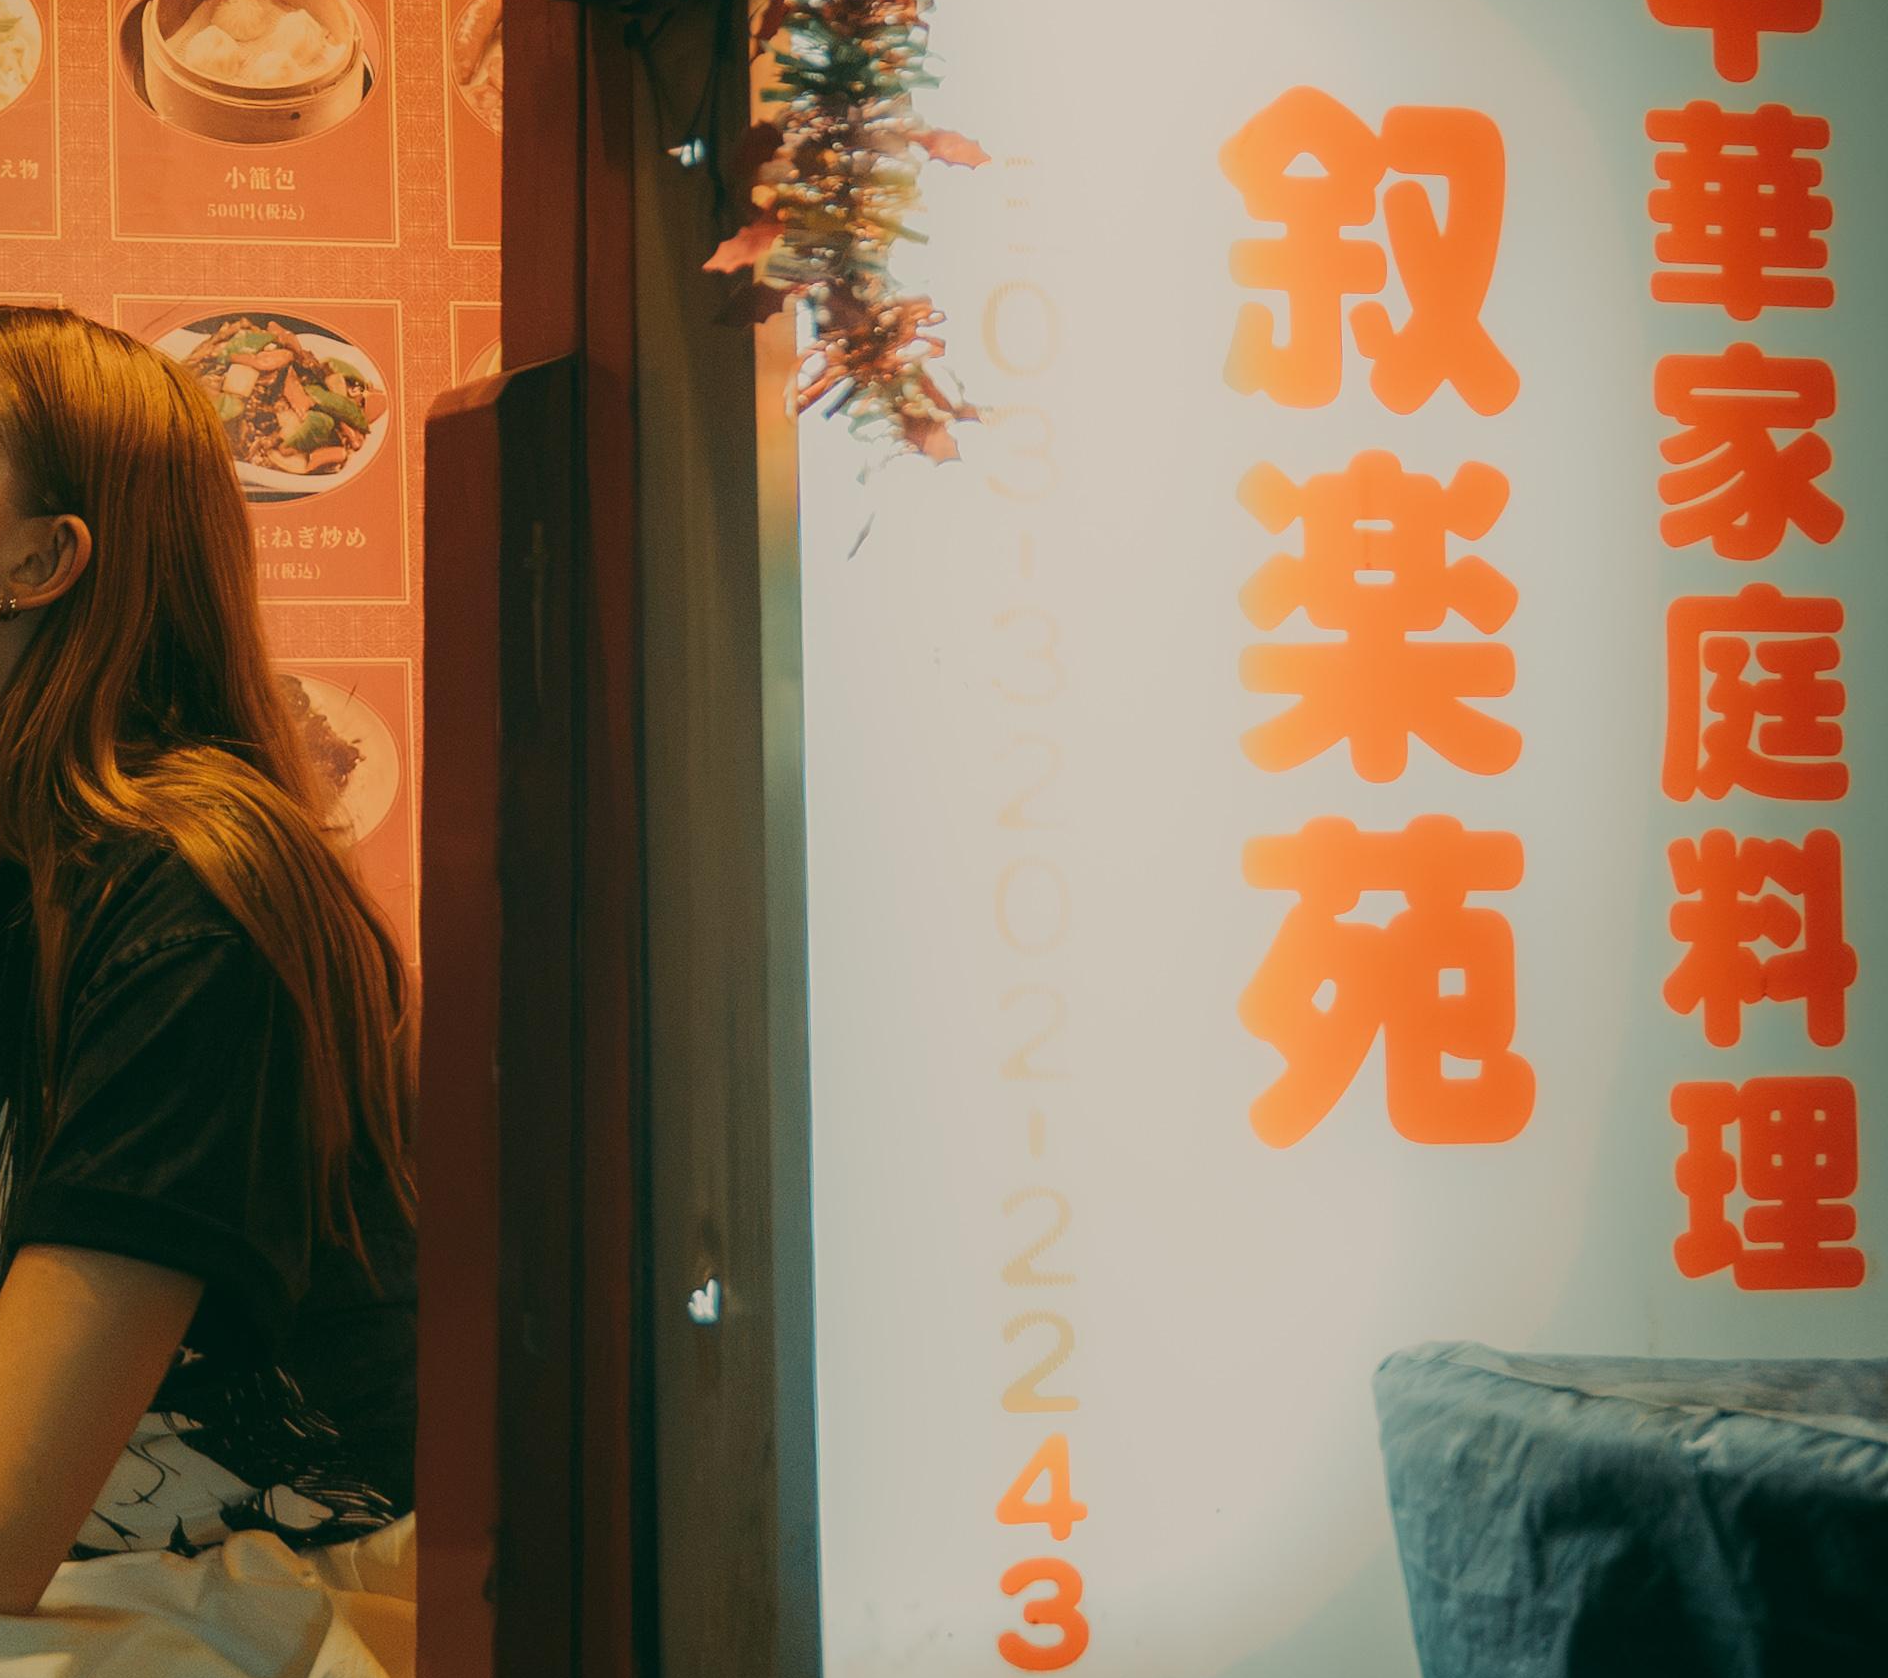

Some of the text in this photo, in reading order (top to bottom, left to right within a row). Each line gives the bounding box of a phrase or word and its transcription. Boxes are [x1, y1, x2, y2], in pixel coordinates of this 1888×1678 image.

[223, 165, 297, 191] 小籠包
[1218, 85, 1537, 1150] 叙楽苑
